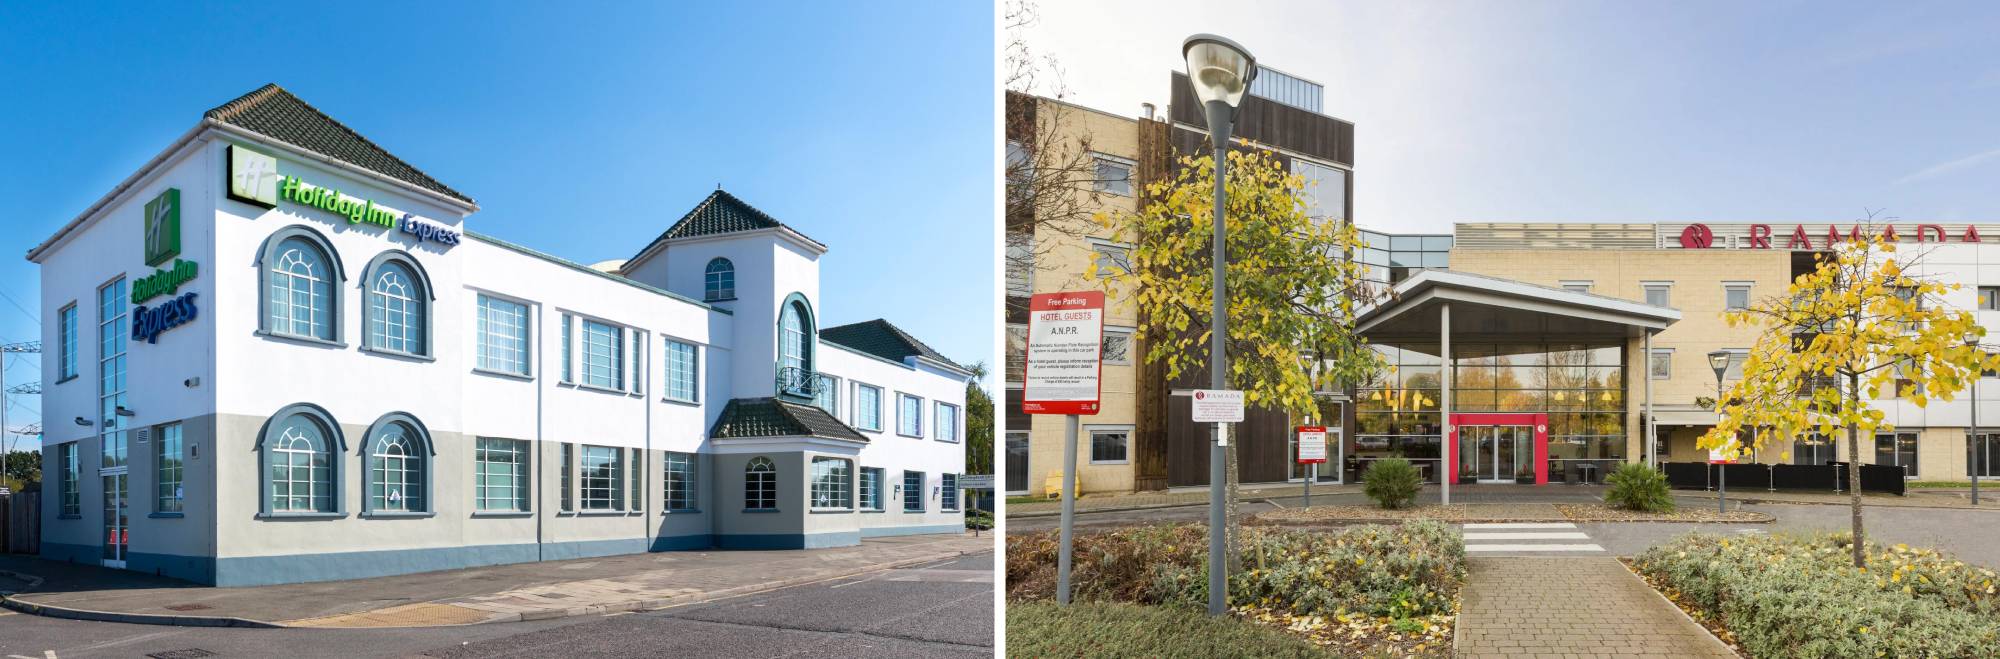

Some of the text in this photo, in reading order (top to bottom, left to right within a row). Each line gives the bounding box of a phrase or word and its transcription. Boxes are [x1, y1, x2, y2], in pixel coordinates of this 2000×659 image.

[400, 213, 462, 247] Express
[1749, 223, 1982, 250] RAMADA
[1047, 297, 1087, 306] Free Parking
[131, 292, 199, 344] Express
[1040, 311, 1092, 321] HOTEL GUESTS
[1050, 326, 1079, 335] A.N.P.R.
